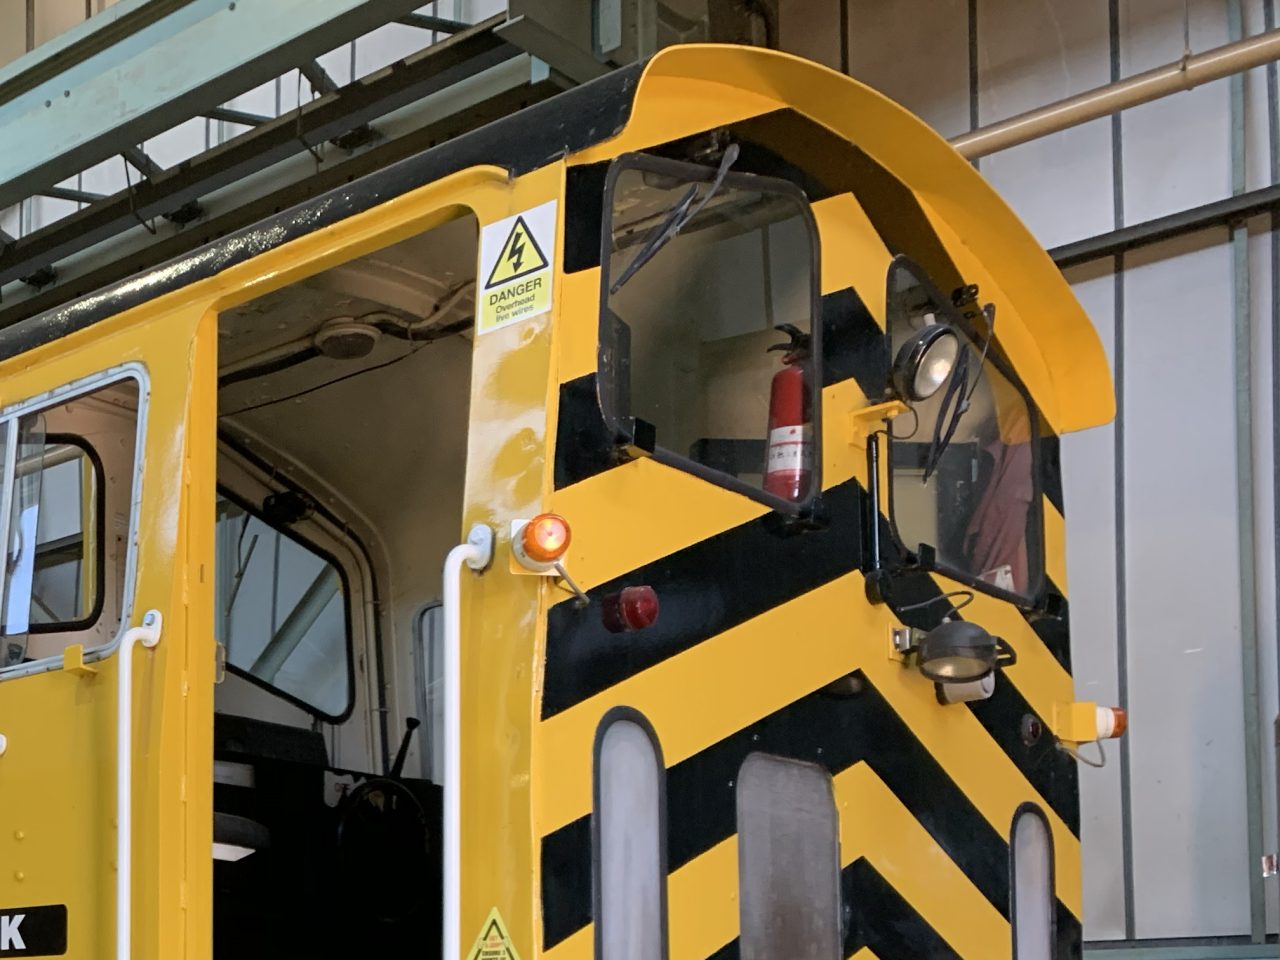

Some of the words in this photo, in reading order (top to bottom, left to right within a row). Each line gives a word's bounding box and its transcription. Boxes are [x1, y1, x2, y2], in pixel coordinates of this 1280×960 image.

[489, 277, 542, 306] DANGER
[495, 294, 535, 314] Overhead
[495, 313, 510, 322] live
[511, 304, 534, 317] wires
